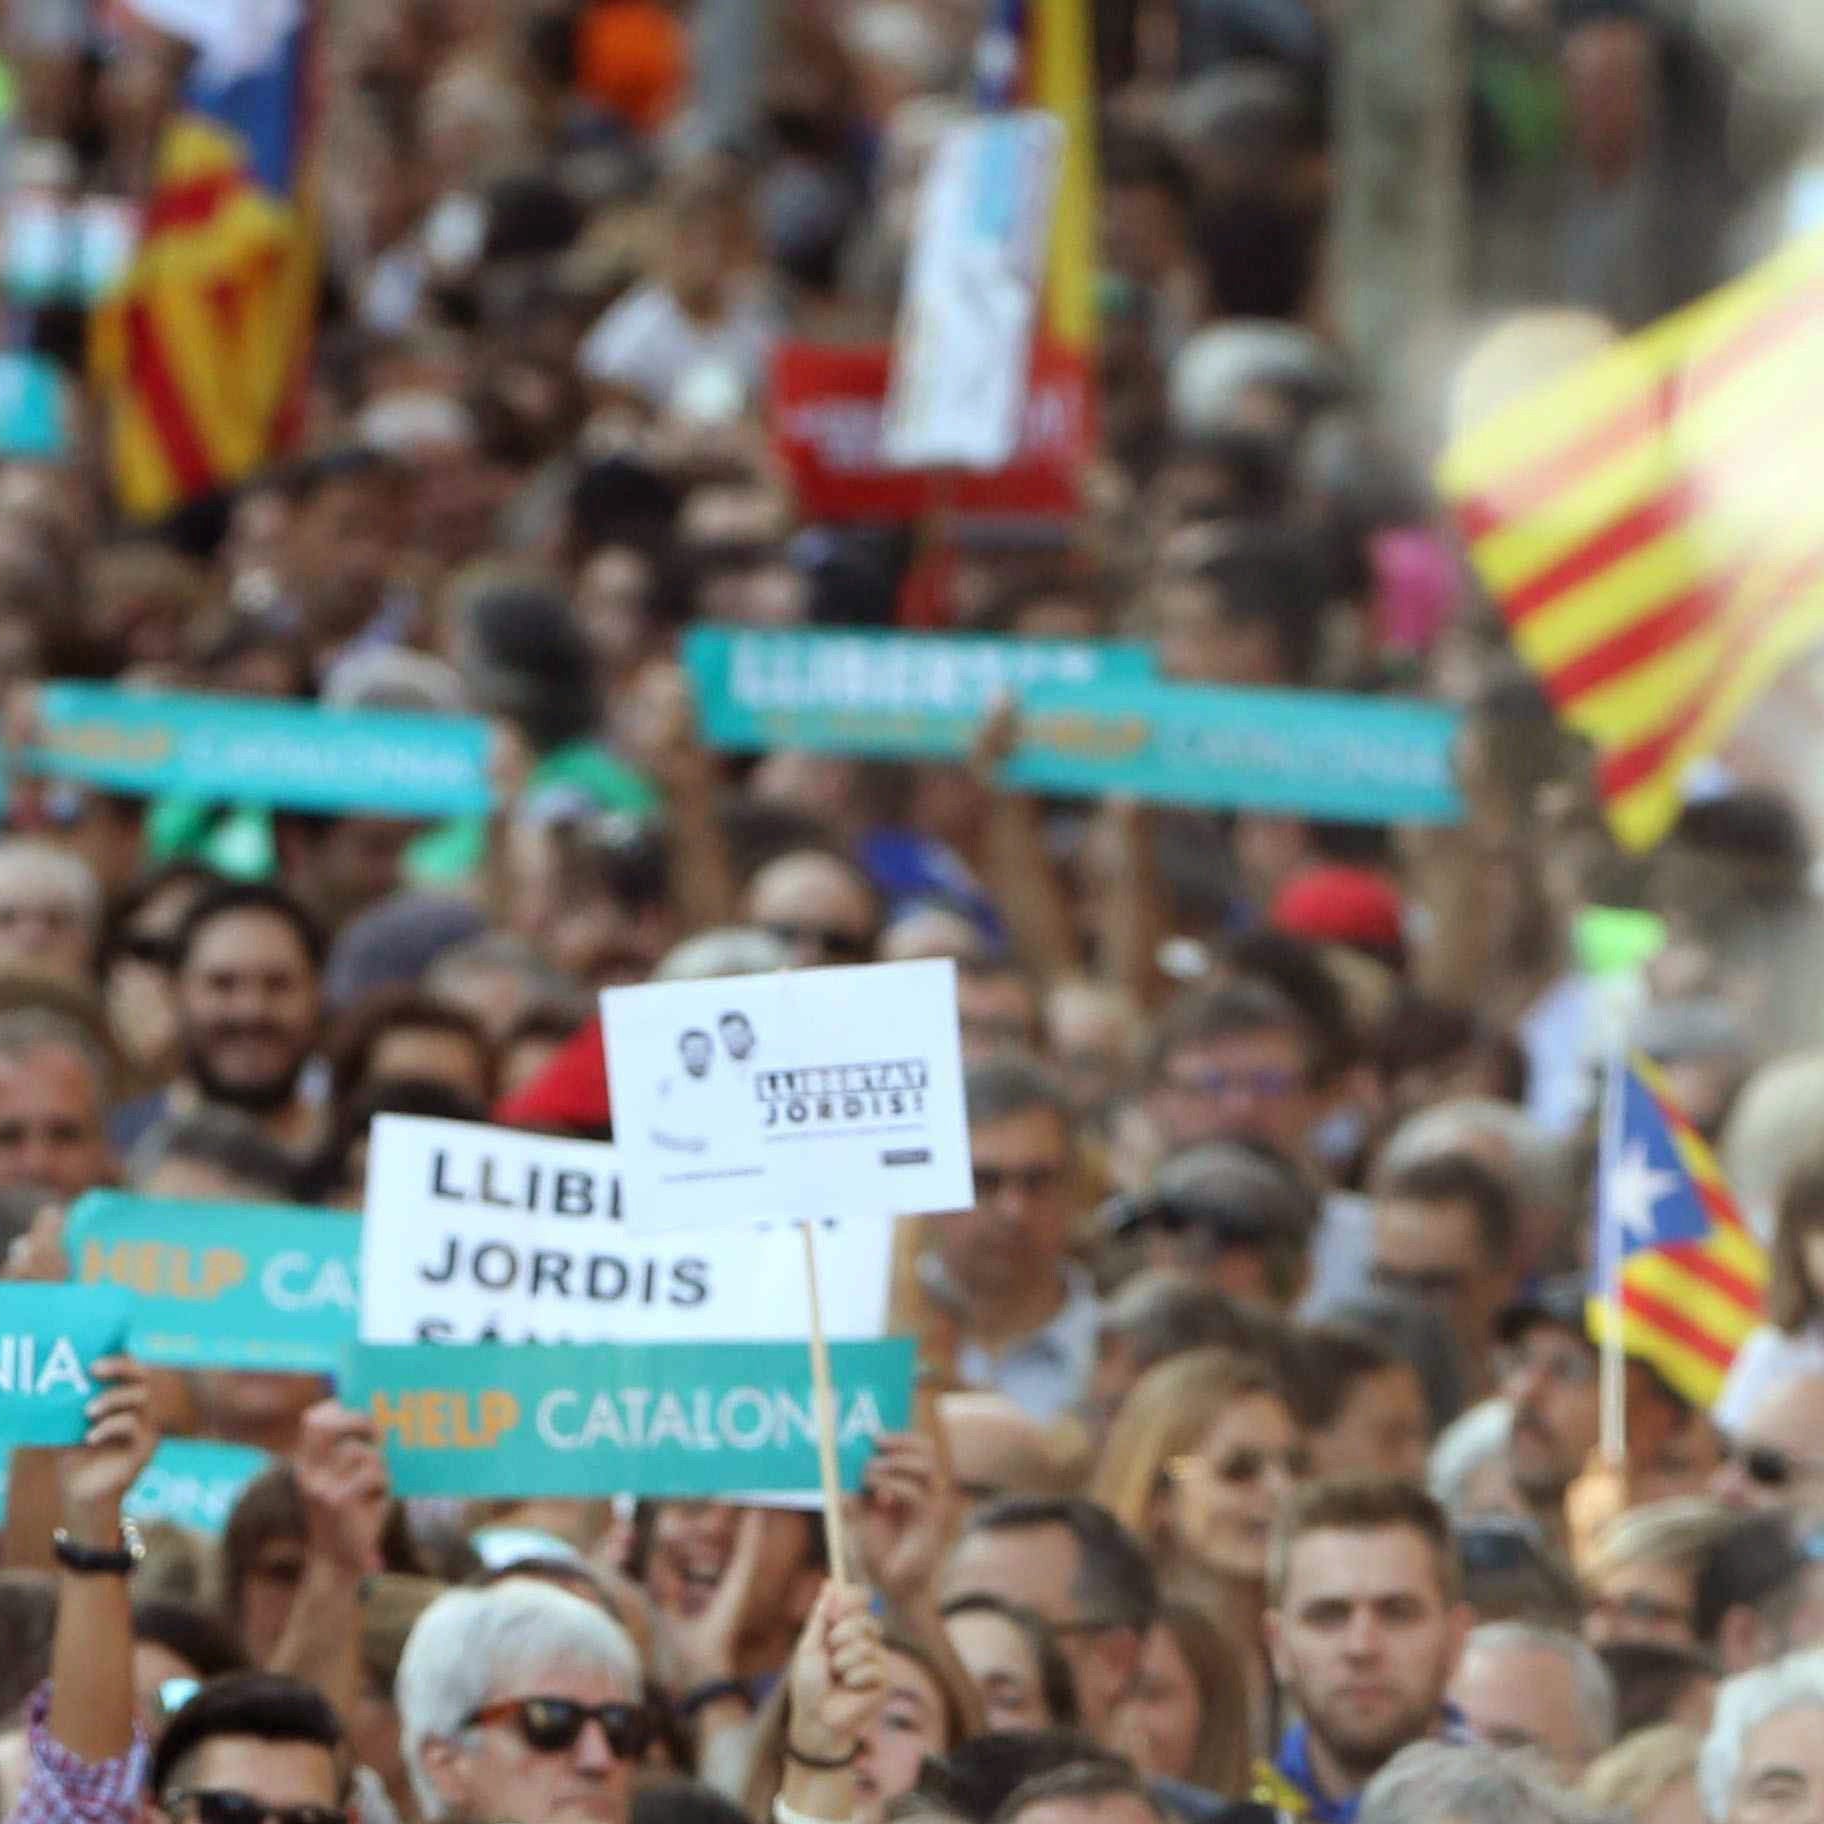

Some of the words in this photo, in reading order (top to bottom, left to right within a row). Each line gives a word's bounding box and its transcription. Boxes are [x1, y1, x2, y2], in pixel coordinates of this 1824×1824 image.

[83, 1239, 246, 1300] HELP
[422, 1237, 712, 1306] JORDIS
[370, 1388, 519, 1449] HELP
